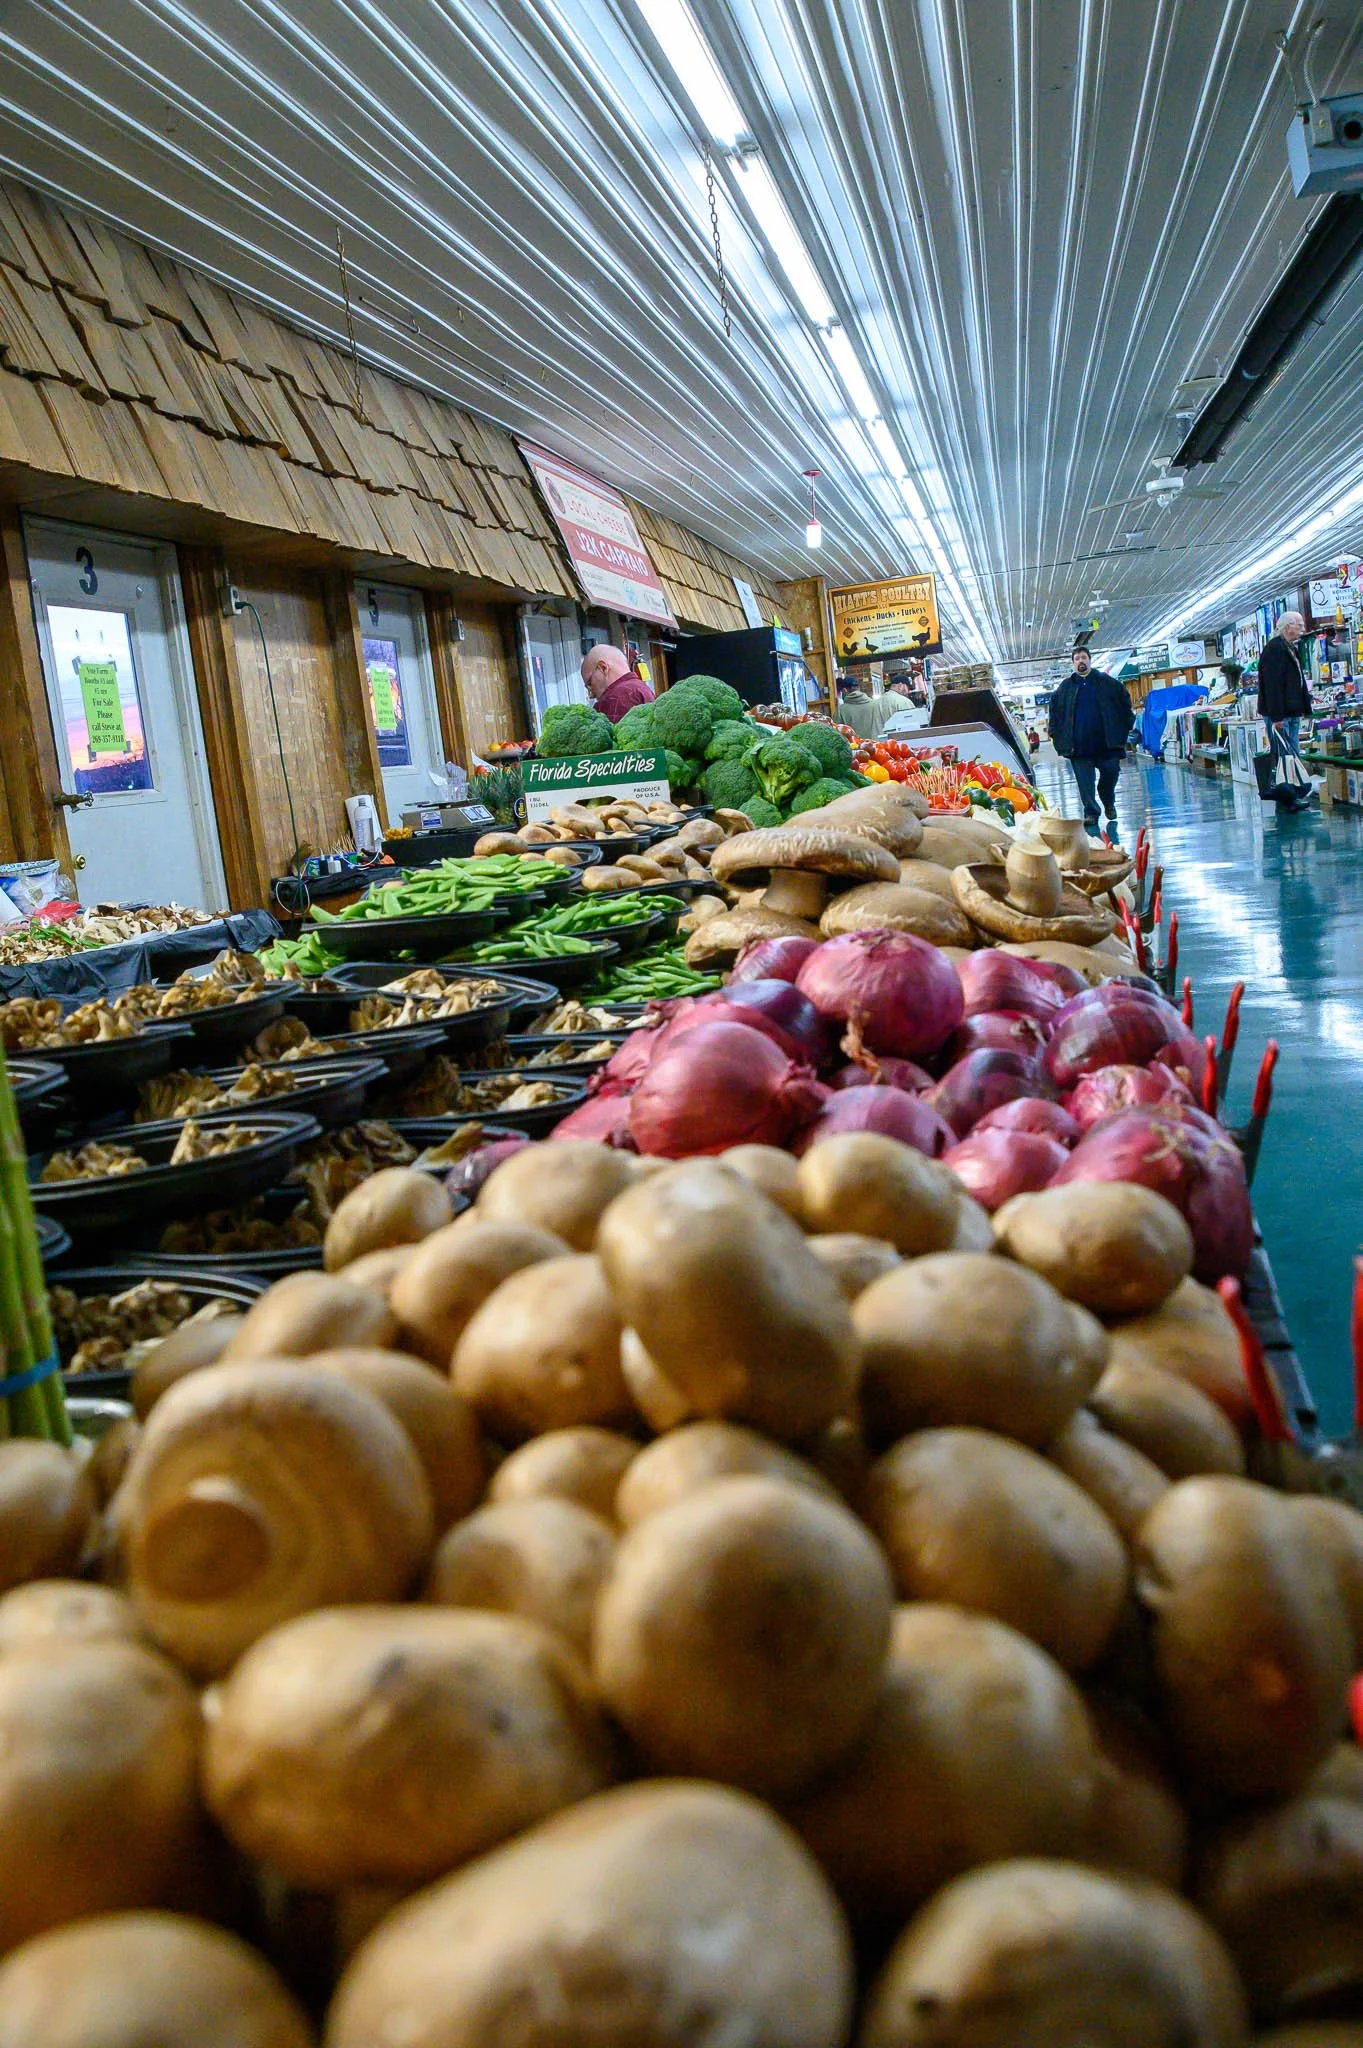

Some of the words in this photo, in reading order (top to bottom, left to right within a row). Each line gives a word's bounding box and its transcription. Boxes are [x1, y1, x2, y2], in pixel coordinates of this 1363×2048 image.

[575, 530, 601, 559] J2K
[600, 540, 650, 577] CAPRAIO
[76, 546, 98, 595] 3
[368, 588, 379, 627] 5
[833, 590, 878, 616] HIATT'S
[880, 582, 931, 602] POULTRY
[843, 615, 872, 625] Chickens
[876, 611, 896, 620] Ducks
[901, 607, 927, 616] Turkeys
[92, 698, 102, 707] For
[103, 698, 114, 706] Sale
[97, 710, 113, 718] Please
[91, 722, 101, 731] call
[101, 722, 115, 731] Steve
[529, 762, 572, 782] Florida
[574, 753, 656, 782] Specialties
